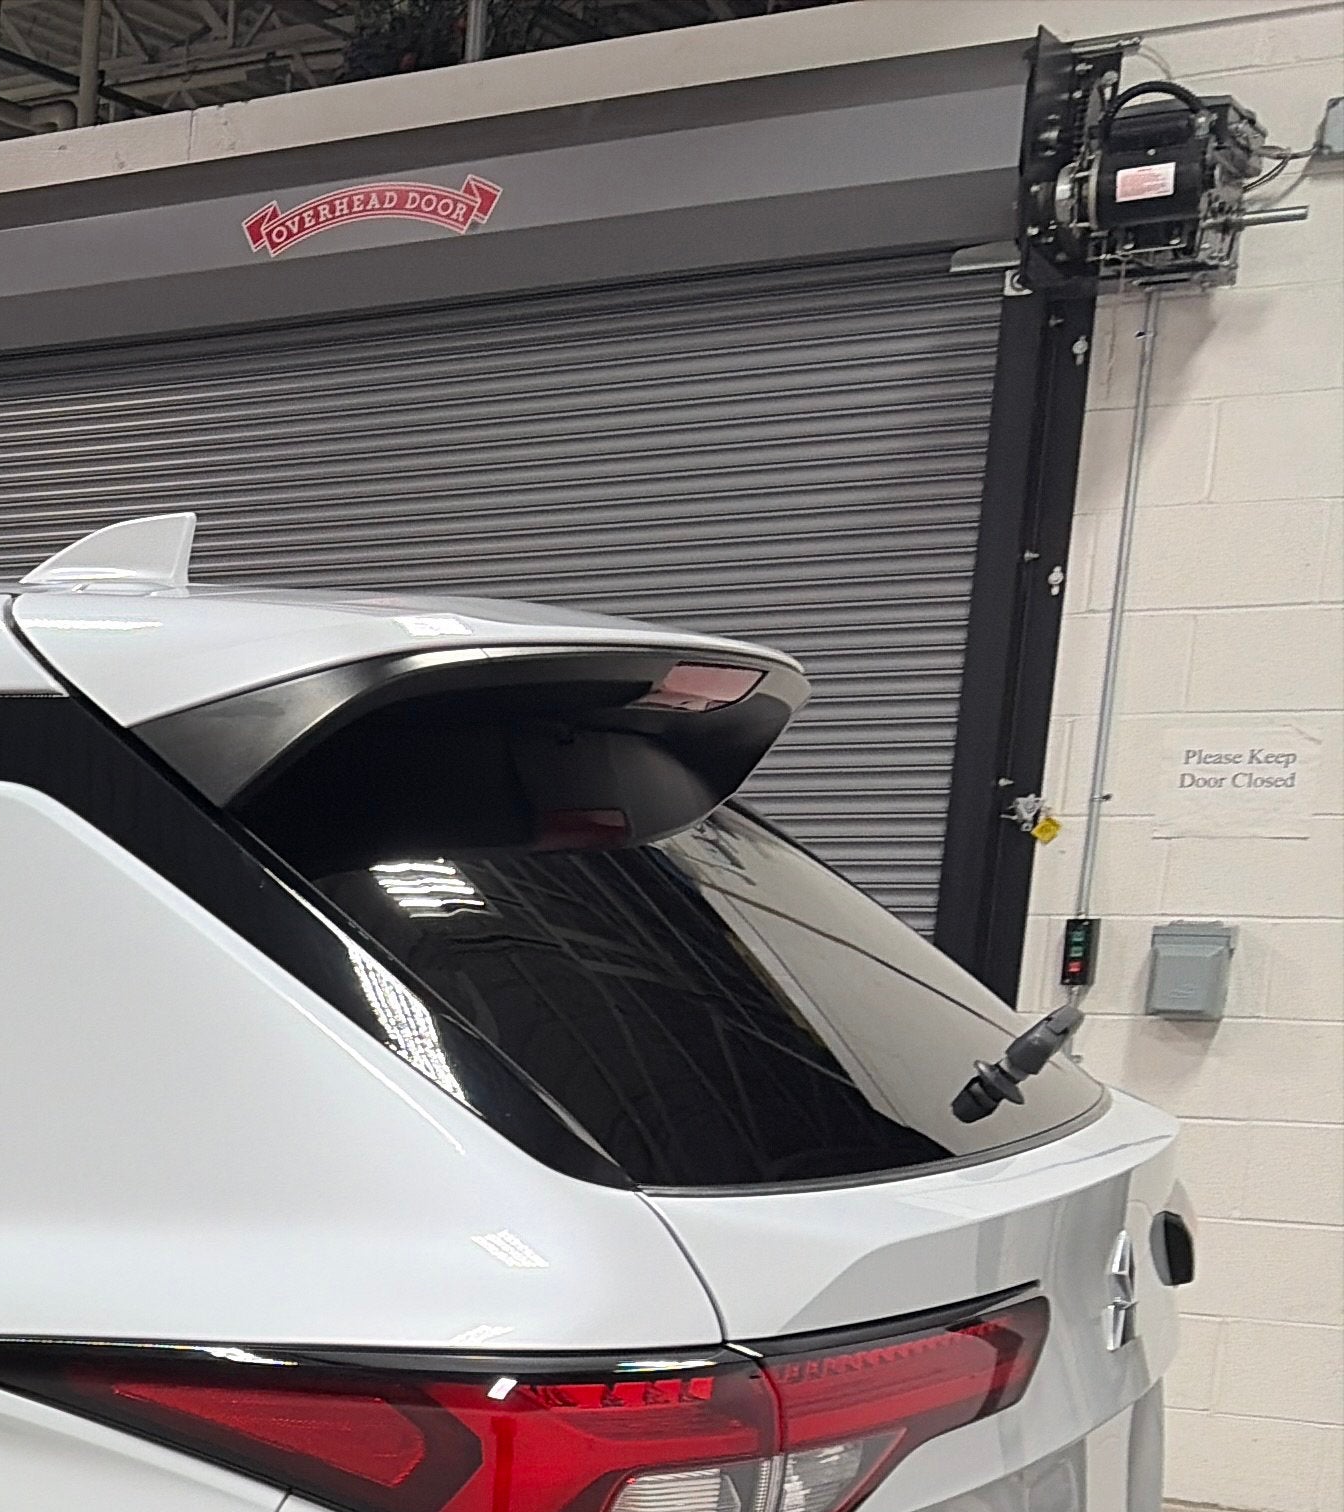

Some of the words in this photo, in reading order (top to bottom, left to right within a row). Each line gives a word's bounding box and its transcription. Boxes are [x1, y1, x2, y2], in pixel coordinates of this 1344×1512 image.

[270, 191, 397, 243] OVERHEAD
[405, 191, 467, 223] DOOR
[1183, 749, 1243, 765] Please
[1247, 748, 1297, 768] Keep
[1178, 772, 1227, 789] Door
[1231, 771, 1296, 789] Closed
